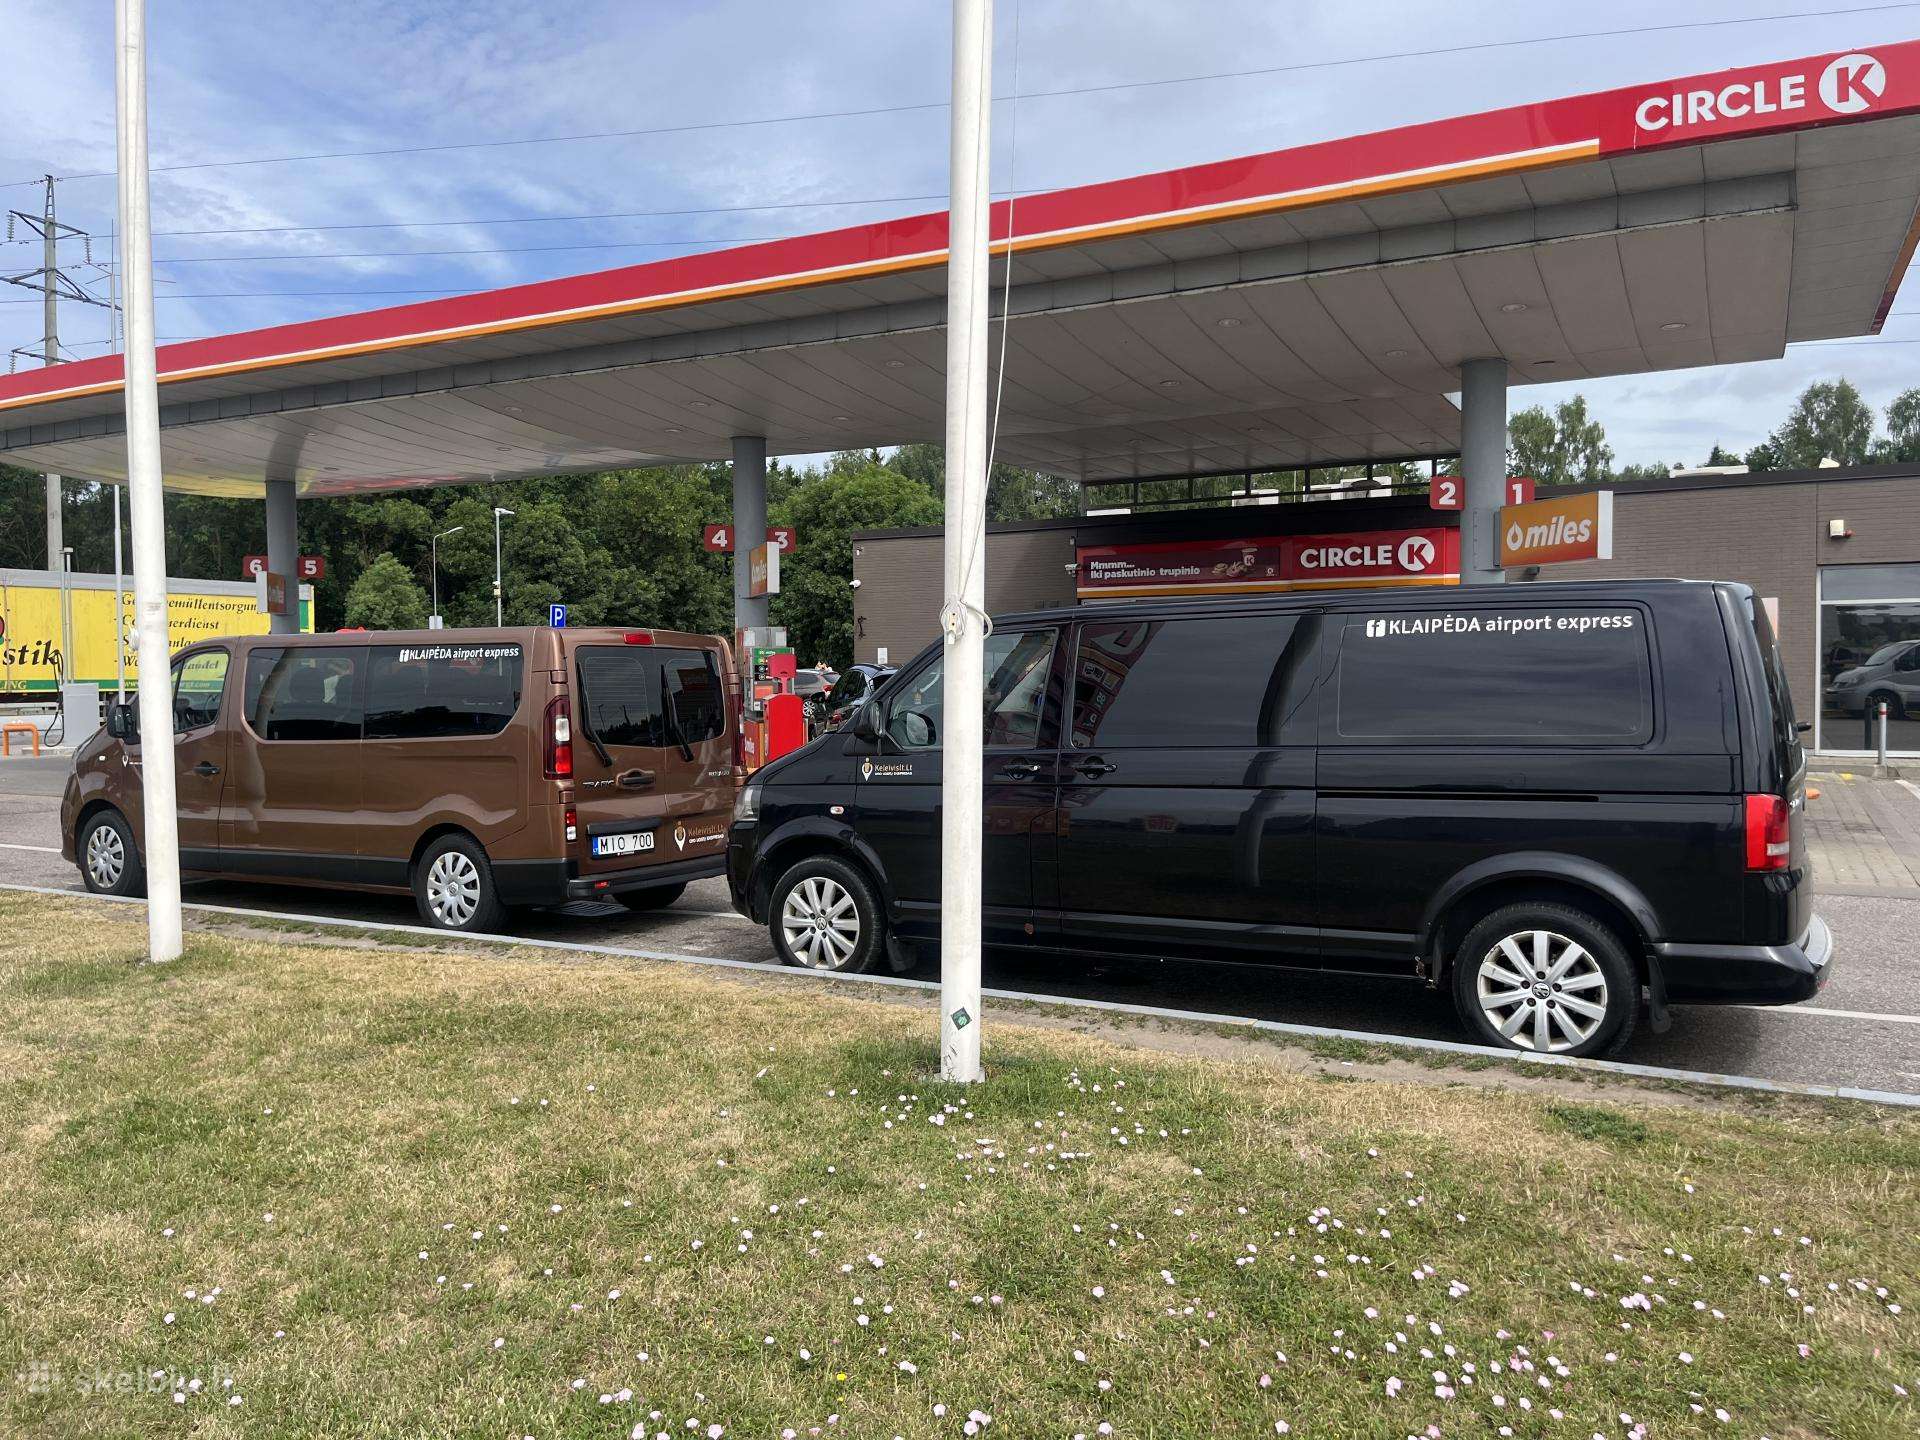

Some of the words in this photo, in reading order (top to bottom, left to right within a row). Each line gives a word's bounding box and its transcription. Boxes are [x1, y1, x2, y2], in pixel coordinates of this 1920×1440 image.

[1635, 74, 1806, 131] CIRCLE
[1438, 481, 1456, 505] 2
[1511, 483, 1523, 504] 1
[711, 529, 728, 547] 4
[774, 531, 789, 549] 3
[1524, 515, 1592, 548] miles
[249, 559, 263, 574] 6
[1300, 545, 1393, 569] CIRCLE
[304, 560, 317, 575] 5
[1104, 568, 1156, 580] paskutinio
[1159, 565, 1200, 577] trupinio
[122, 594, 261, 614] Gemüllentsorgun
[554, 607, 563, 626] P
[1388, 614, 1481, 635] KLAIPĖDA
[1485, 615, 1552, 635] airport
[1556, 615, 1633, 634] express
[409, 646, 452, 660] KLAIPĖDA
[452, 647, 484, 660] airport
[484, 647, 519, 660] express
[600, 836, 626, 853] MIO
[632, 834, 652, 849] 700
